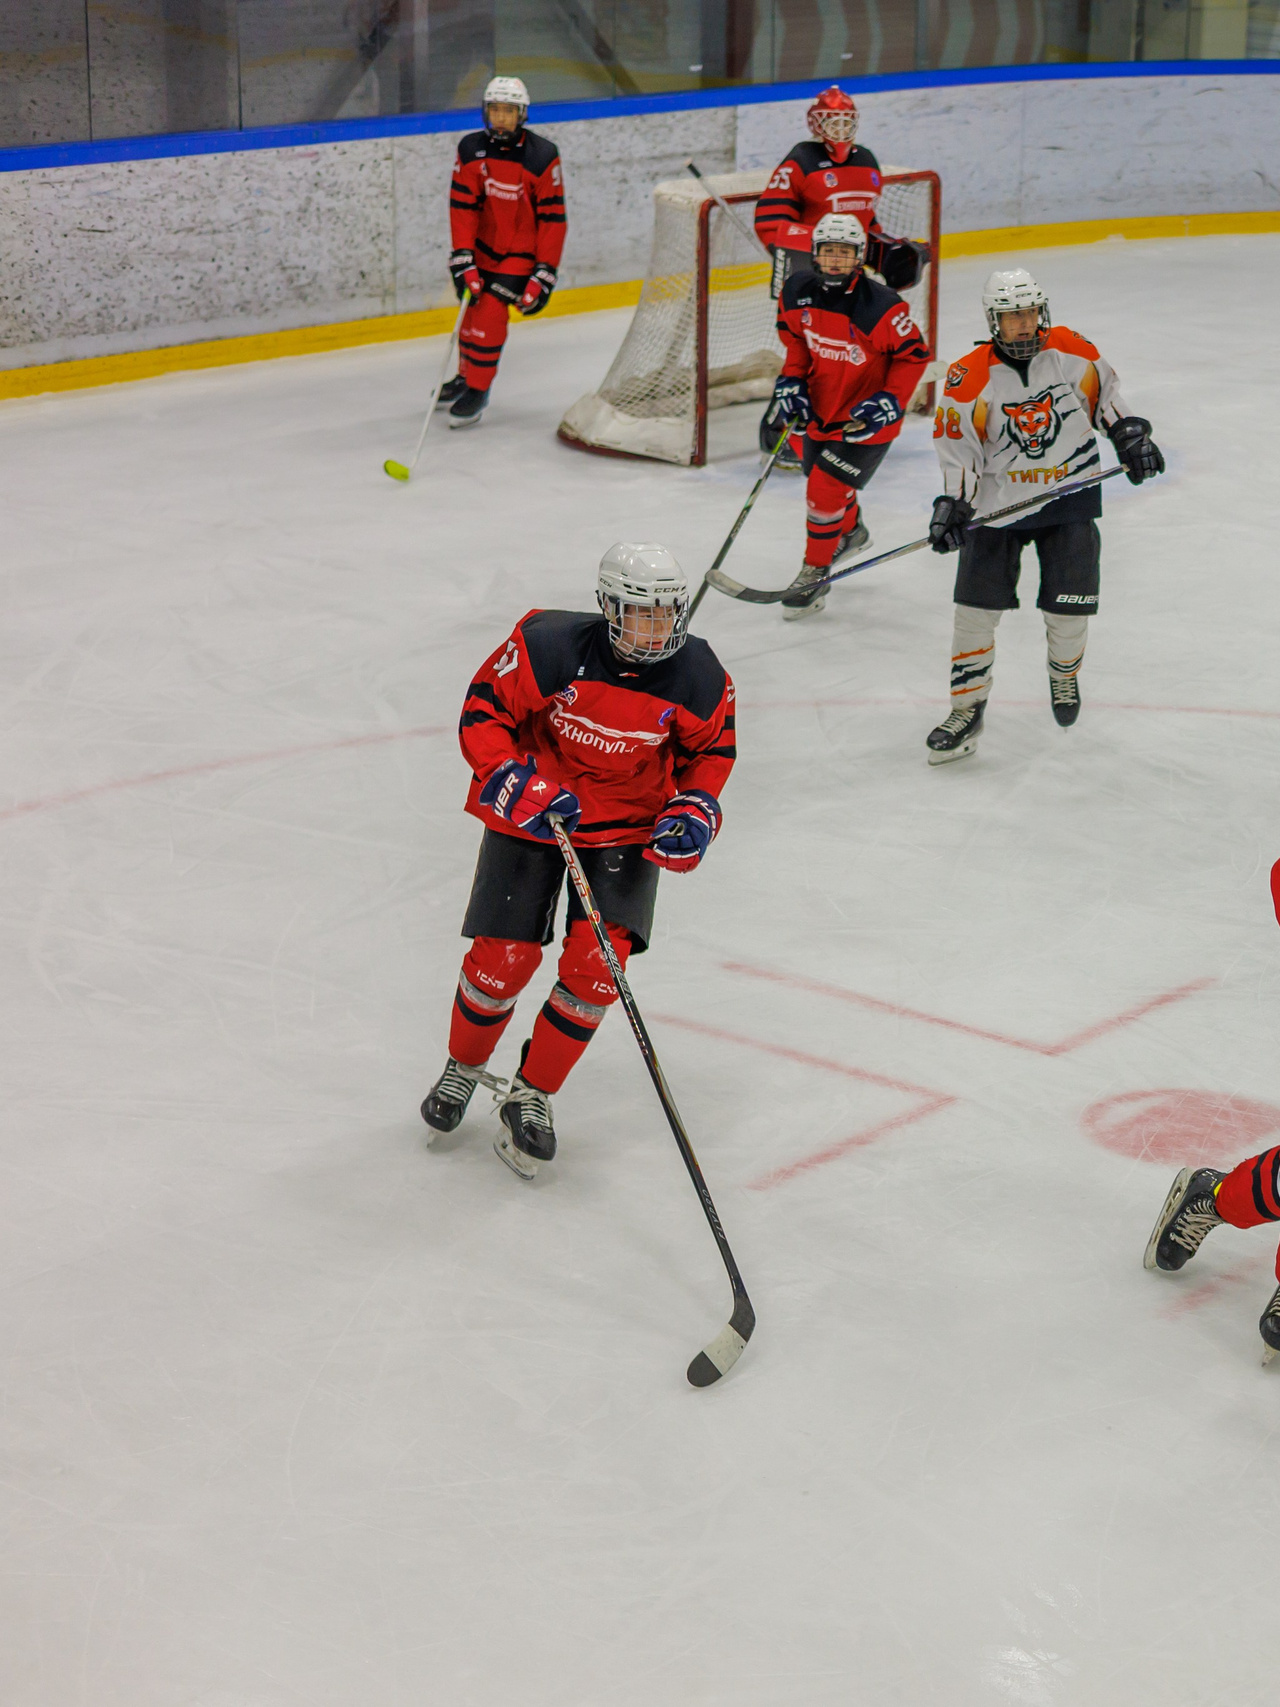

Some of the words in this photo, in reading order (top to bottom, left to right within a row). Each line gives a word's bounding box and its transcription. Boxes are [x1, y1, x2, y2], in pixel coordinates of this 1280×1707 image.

[820, 448, 862, 478] BAUER
[1007, 462, 1069, 485] ТИГРЫ
[653, 586, 680, 594] CCM
